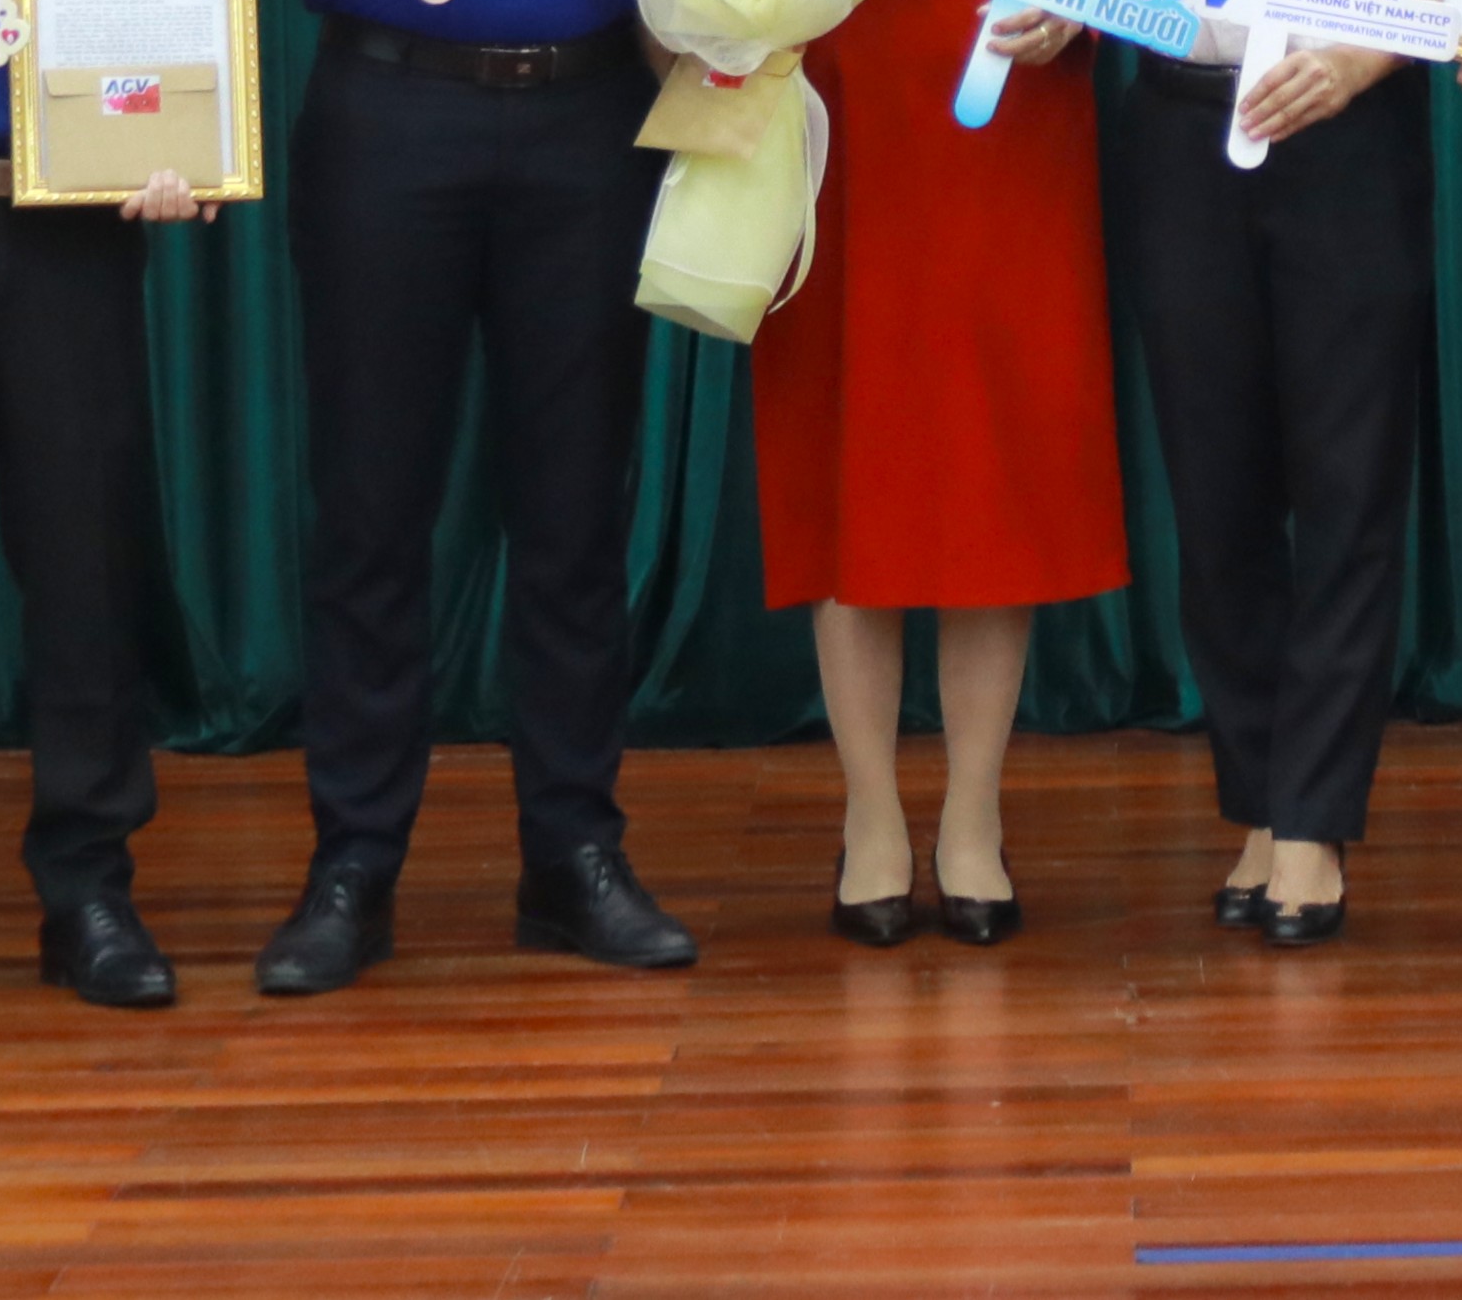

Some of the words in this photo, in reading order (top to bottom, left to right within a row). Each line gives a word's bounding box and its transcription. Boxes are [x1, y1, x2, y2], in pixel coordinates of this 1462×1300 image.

[1354, 0, 1382, 15] VIỆT
[1385, 6, 1451, 27] NAM-CTCP
[1264, 9, 1313, 26] AIRPORTS
[1315, 18, 1383, 39] CORPORATION
[1385, 31, 1399, 41] OF
[1401, 34, 1447, 50] VIETNAM
[104, 78, 150, 98] ACV
